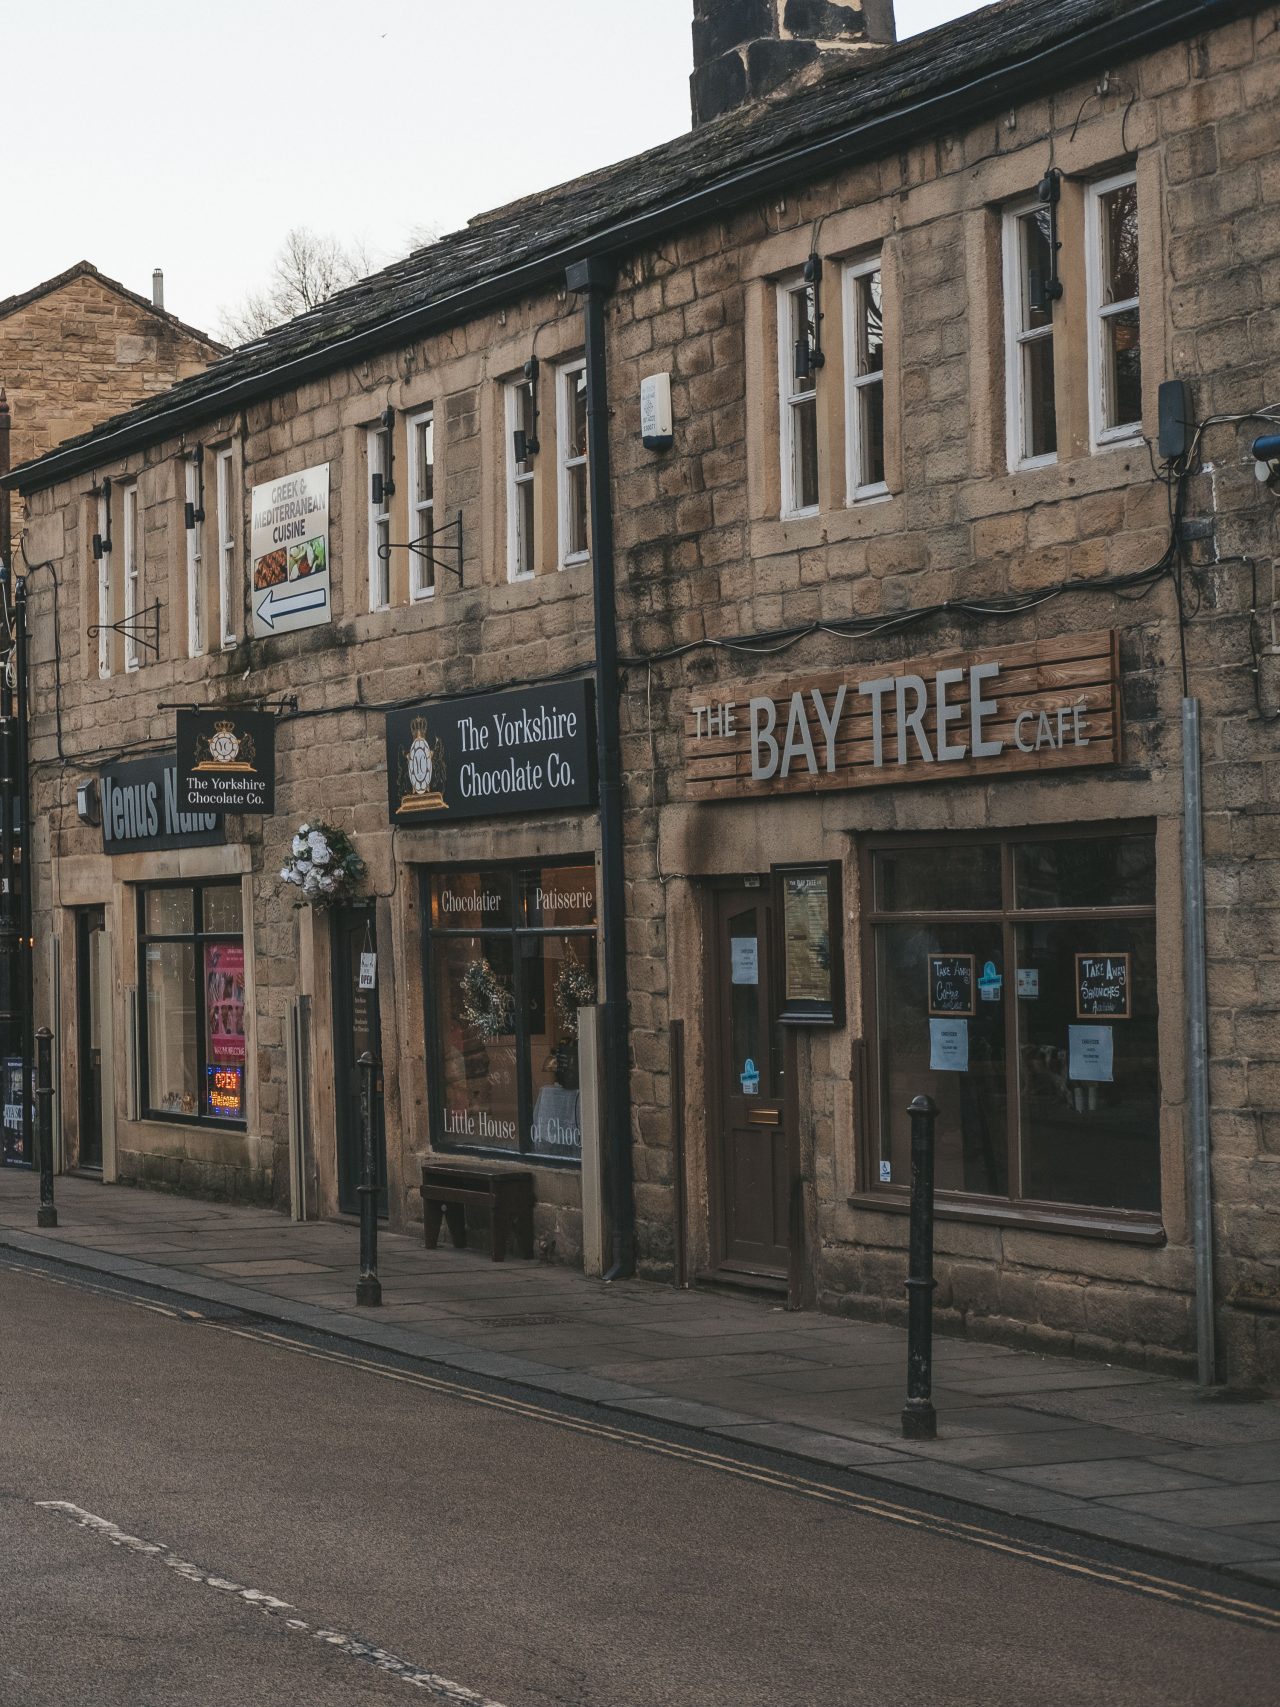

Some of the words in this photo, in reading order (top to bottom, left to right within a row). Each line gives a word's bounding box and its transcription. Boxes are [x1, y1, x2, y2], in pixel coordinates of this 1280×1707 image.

[272, 482, 298, 503] GREEK
[299, 478, 307, 494] &
[254, 492, 326, 530] MEDITERRANEAN
[273, 519, 306, 543] CUISINE
[458, 716, 489, 752] The
[493, 705, 577, 747] Yorkshire
[692, 702, 736, 740] THE
[750, 684, 848, 780] BAY
[859, 662, 1004, 767] TREE
[1014, 693, 1090, 753] CAFÉ
[186, 777, 208, 790] The
[211, 778, 266, 790] Yorkshire
[460, 757, 543, 798] Chocolate
[547, 753, 575, 787] Co.
[100, 776, 158, 840] Venus
[188, 791, 243, 804] Chocolate
[247, 792, 264, 804] Co.
[441, 888, 501, 913] Chocolatier
[536, 887, 593, 911] Patisserie
[215, 1073, 236, 1089] OPEN
[443, 1108, 475, 1136] Little
[478, 1111, 516, 1140] House
[530, 1119, 544, 1143] of
